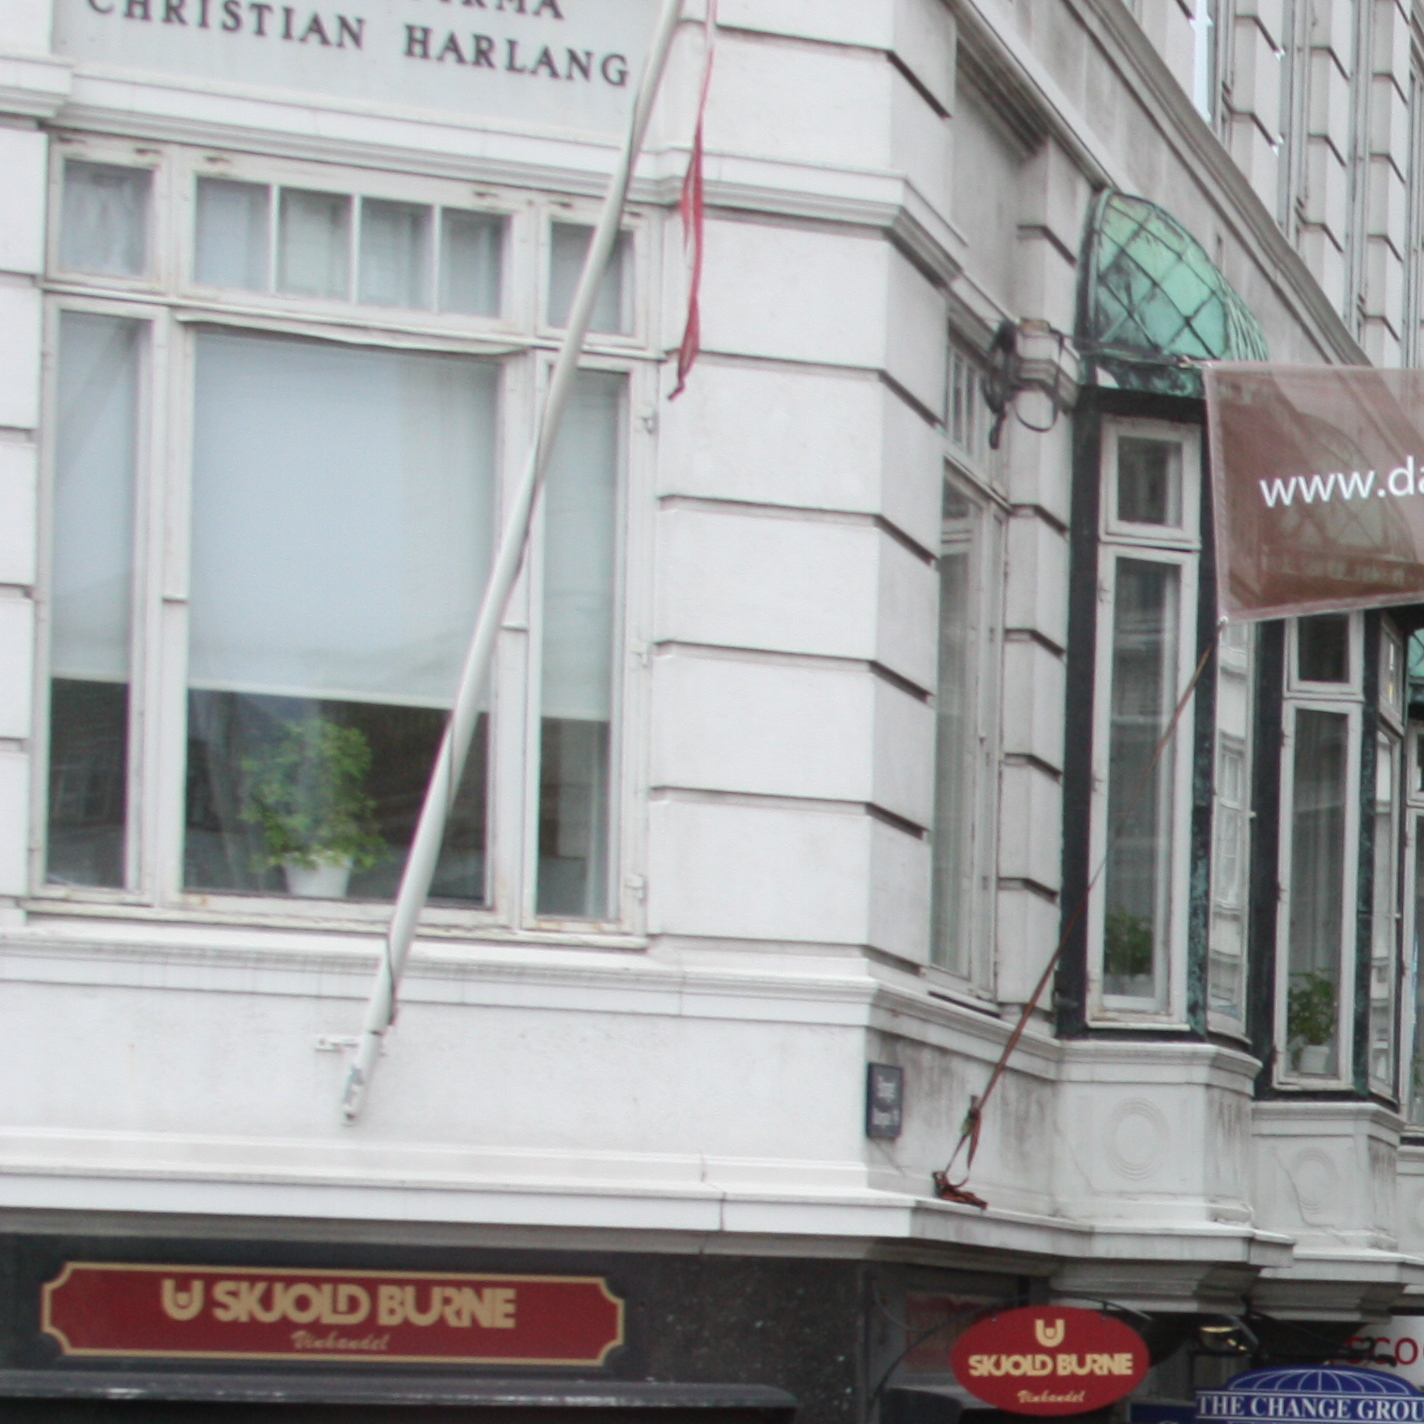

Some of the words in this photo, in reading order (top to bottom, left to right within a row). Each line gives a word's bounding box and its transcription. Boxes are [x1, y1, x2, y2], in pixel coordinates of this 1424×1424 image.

[403, 23, 630, 87] HARLANG
[212, 1280, 371, 1326] SKJOLD
[377, 1284, 516, 1329] BURNE
[291, 1330, 391, 1351] Vinhandel
[968, 1354, 1054, 1376] SKJOLD
[1056, 1353, 1134, 1376] BURNE
[1017, 1389, 1086, 1403] Vinhandel
[1199, 1395, 1245, 1416] THE
[1251, 1396, 1350, 1420] CHANGE
